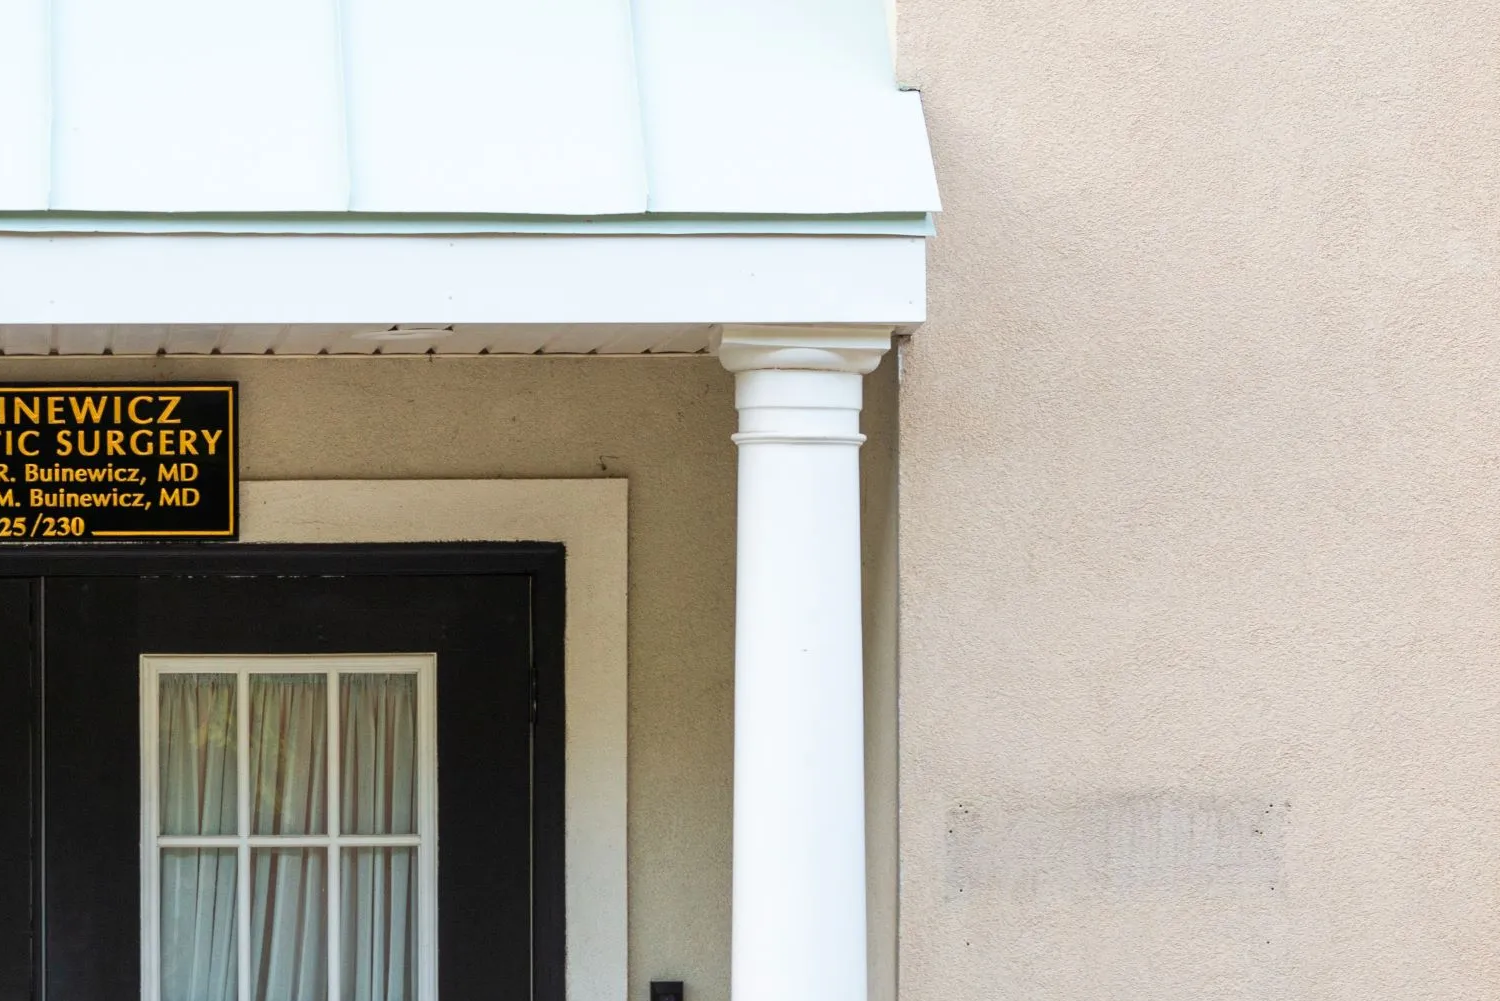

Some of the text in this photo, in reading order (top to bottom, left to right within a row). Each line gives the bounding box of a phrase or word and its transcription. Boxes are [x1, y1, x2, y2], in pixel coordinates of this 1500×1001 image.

[56, 430, 223, 457] SURGERY
[25, 463, 146, 486] Buinewicz,
[158, 463, 199, 482] MD
[30, 488, 151, 510] Buinewicz,
[160, 488, 200, 507] MD
